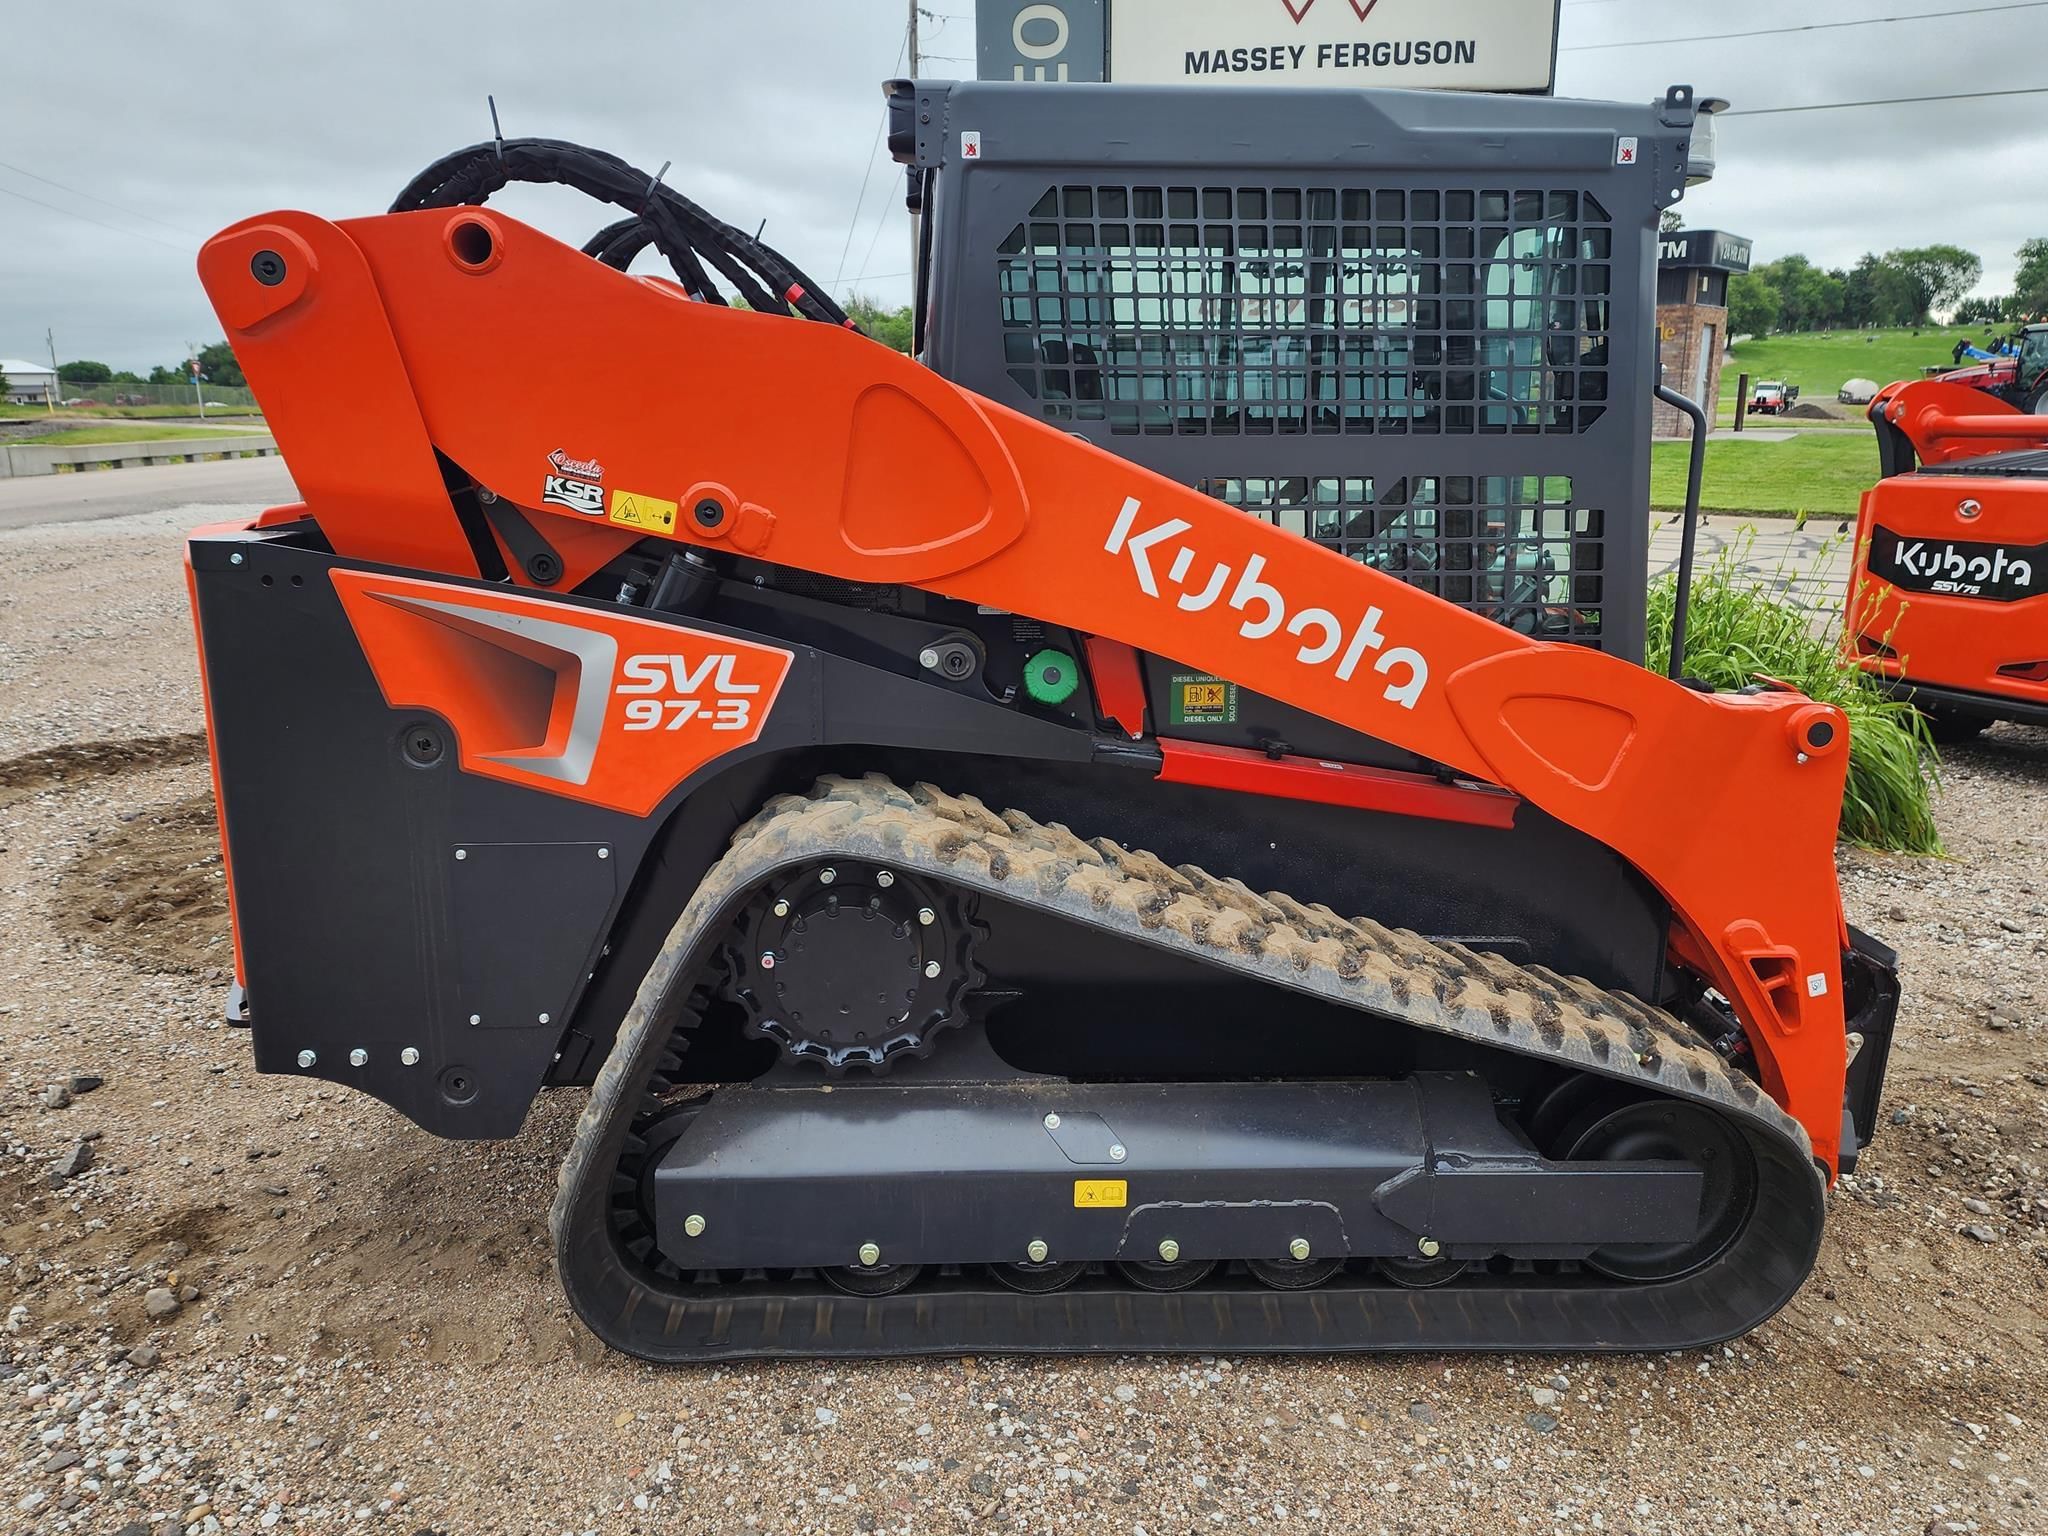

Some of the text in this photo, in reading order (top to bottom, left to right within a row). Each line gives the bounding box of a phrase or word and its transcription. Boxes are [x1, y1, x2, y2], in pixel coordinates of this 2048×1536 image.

[1184, 40, 1476, 75] MASSEY FERGUSON
[545, 475, 604, 503] KSR
[1894, 541, 2032, 586] Kubota
[1104, 496, 1429, 710] Kubota
[615, 654, 761, 694] SVL
[623, 699, 751, 731] 97-3
